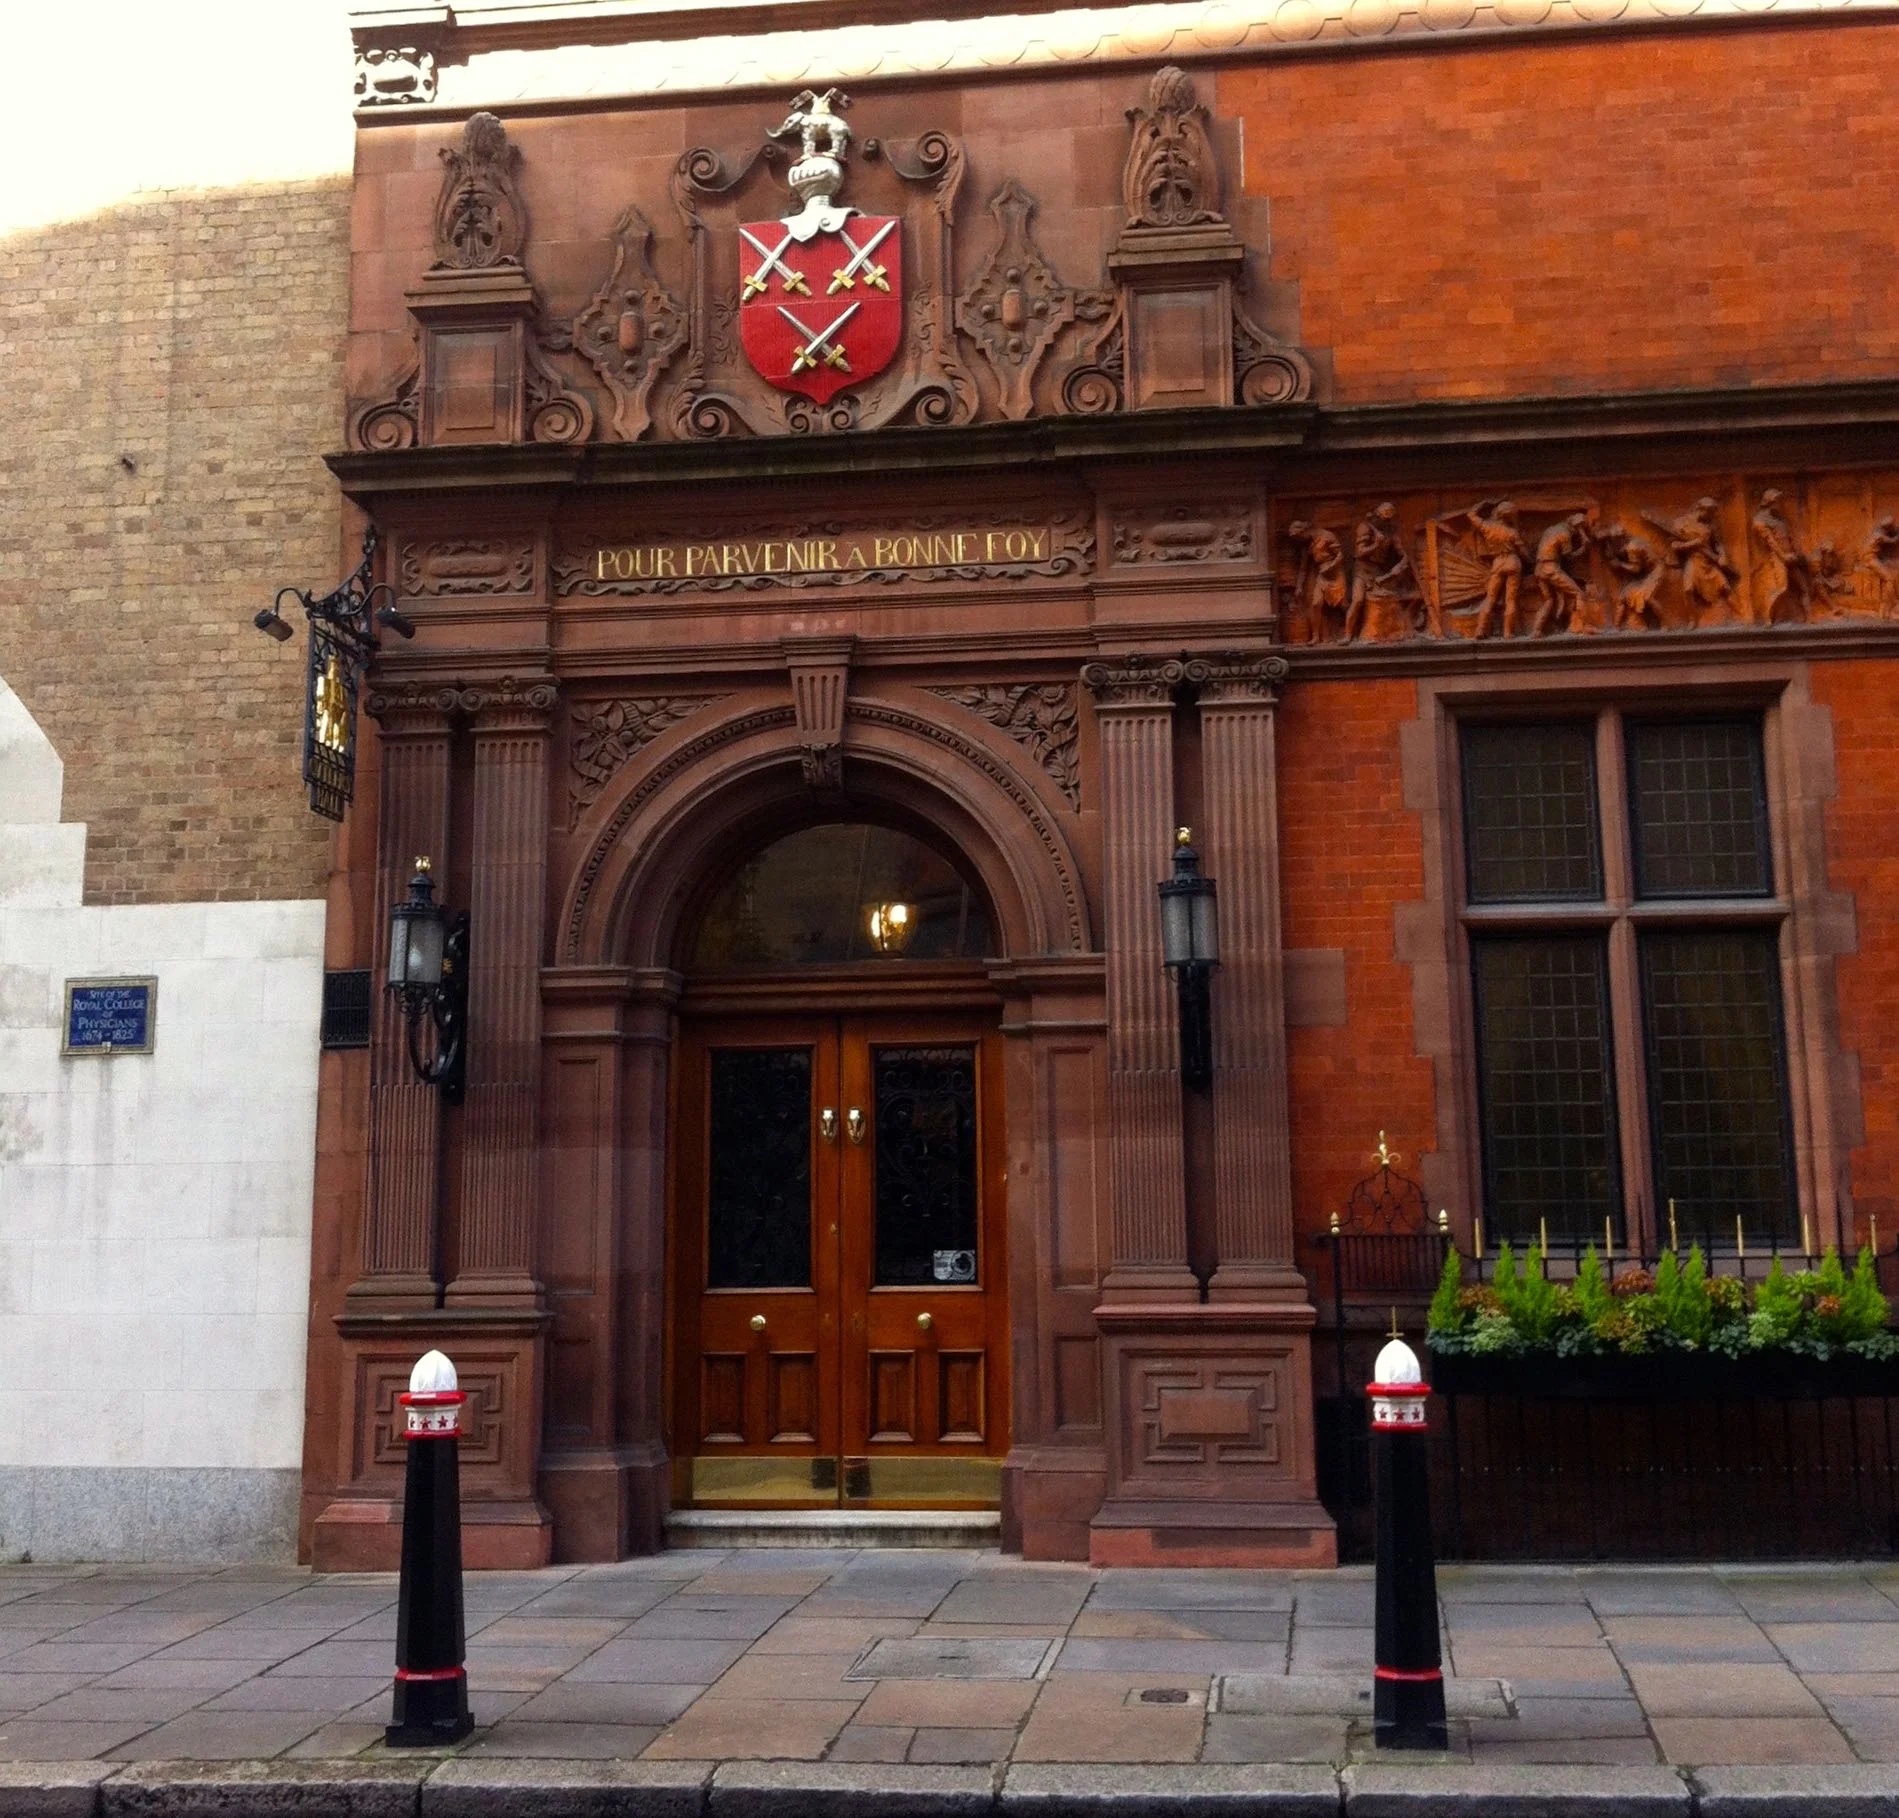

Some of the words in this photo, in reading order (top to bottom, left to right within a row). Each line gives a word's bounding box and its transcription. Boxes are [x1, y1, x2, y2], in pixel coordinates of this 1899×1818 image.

[597, 547, 677, 580] POUR
[685, 538, 843, 576] PARVENIR
[873, 532, 980, 567] BONNE
[985, 528, 1047, 562] FOY
[73, 999, 102, 1011] ROYAL
[104, 998, 145, 1010] COLLEGE
[77, 1017, 138, 1029] PHYSICIANS
